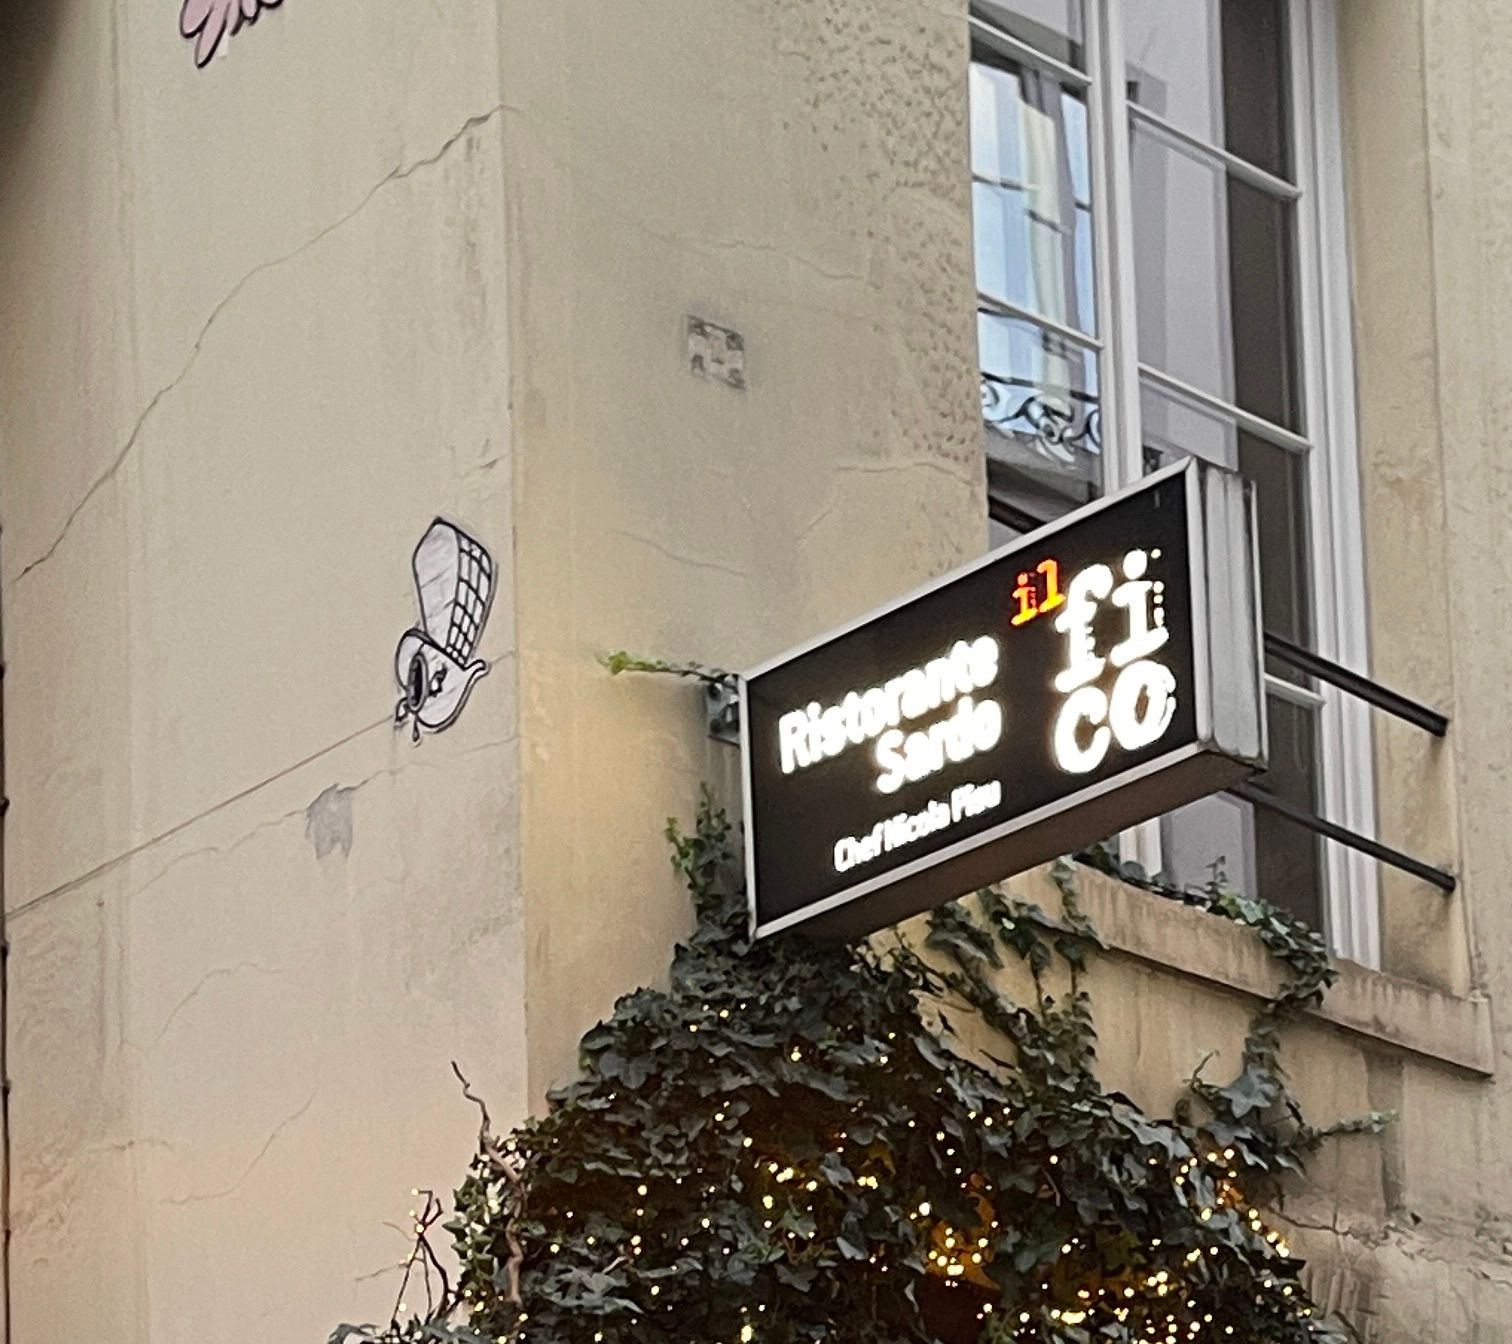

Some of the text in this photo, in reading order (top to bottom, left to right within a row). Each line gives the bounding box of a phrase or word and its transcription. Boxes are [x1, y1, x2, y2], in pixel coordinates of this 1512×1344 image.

[1012, 559, 1065, 626] il
[779, 635, 999, 773] Ristorante
[876, 696, 1001, 793] Sardo
[835, 823, 883, 872] Chef
